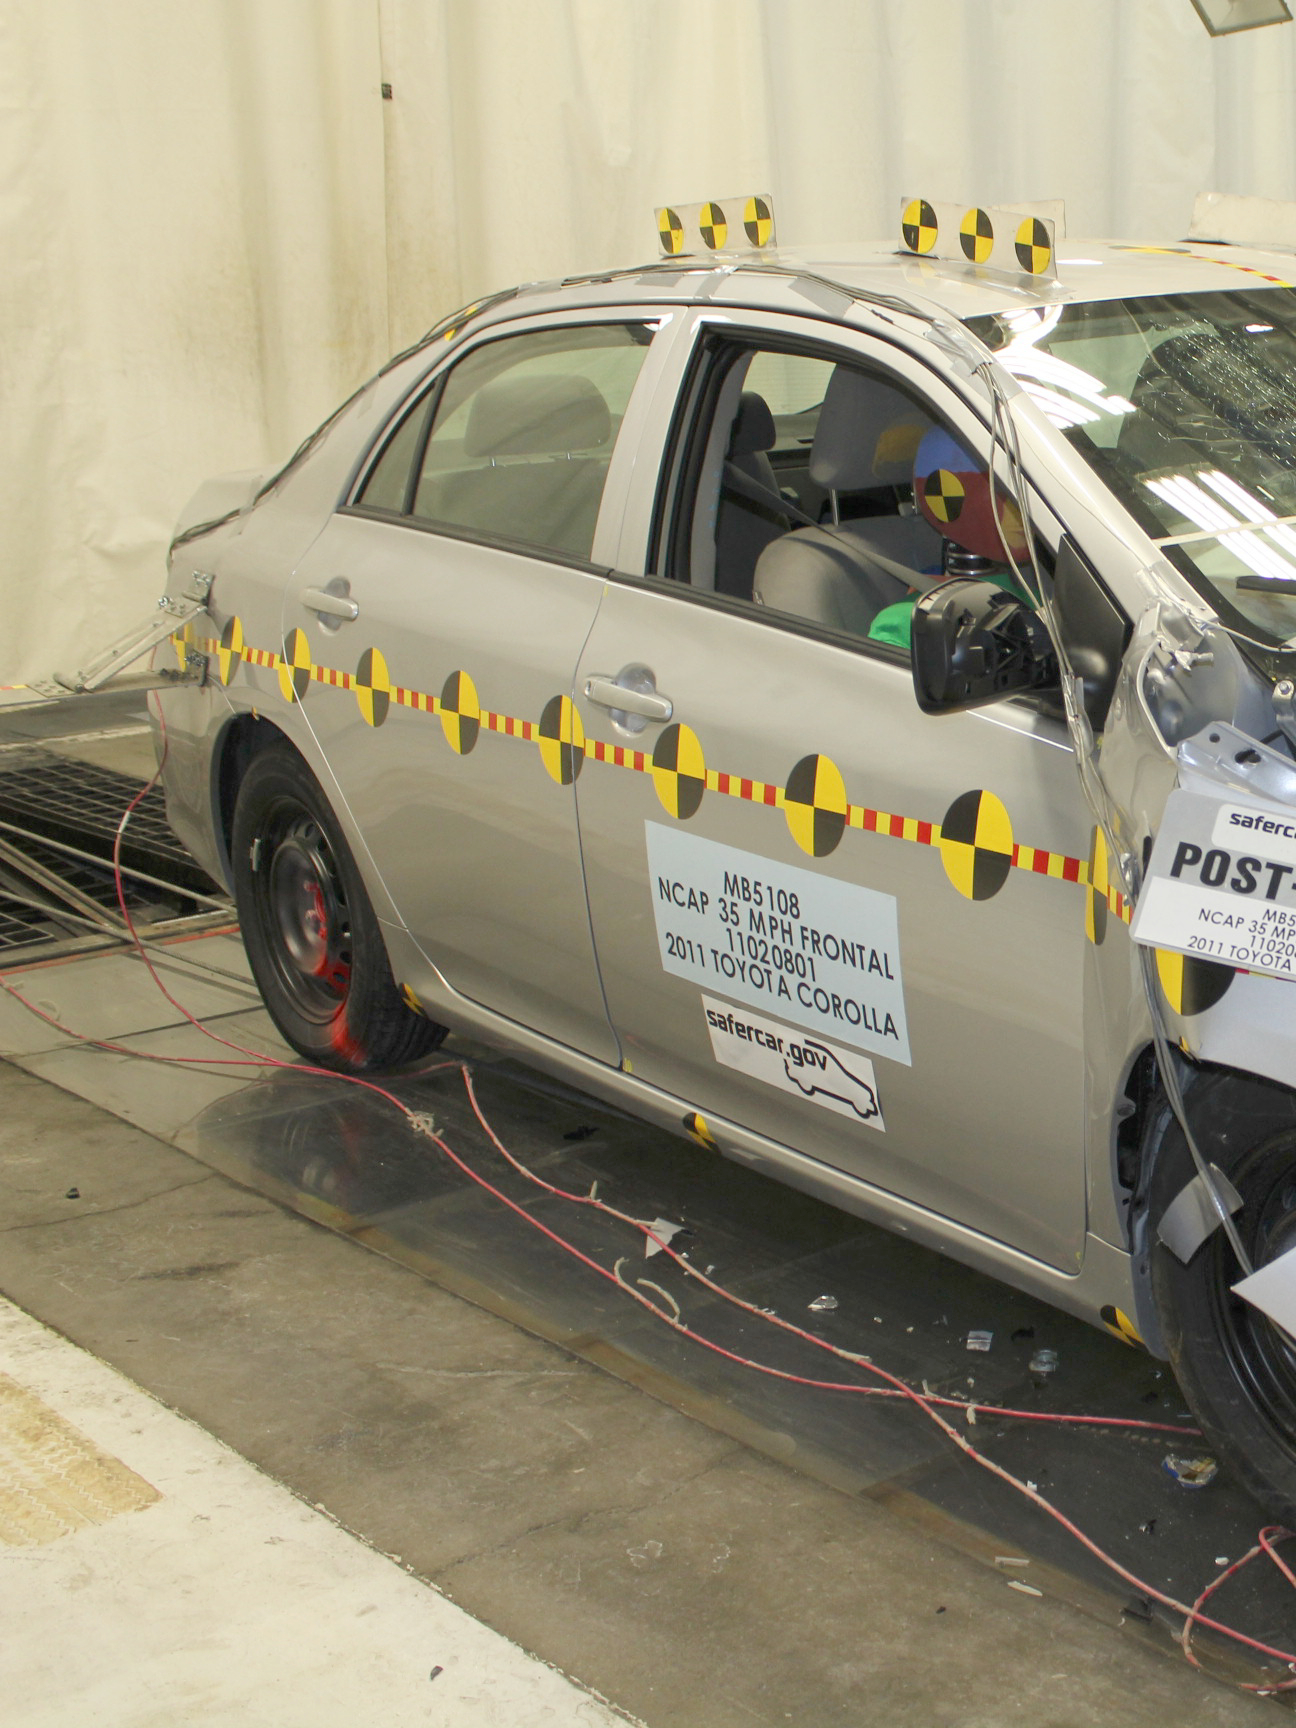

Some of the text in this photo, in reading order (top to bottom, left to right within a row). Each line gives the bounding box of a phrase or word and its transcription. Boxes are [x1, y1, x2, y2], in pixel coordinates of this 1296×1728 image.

[724, 871, 800, 919] MB5108
[1199, 908, 1245, 929] NCAP
[1248, 919, 1267, 934] 35
[658, 876, 894, 980] NCAP 35 MPH FRONTAL
[726, 928, 816, 981] 11020801
[1187, 935, 1224, 956] 2011
[1230, 946, 1291, 972] TOYOTA
[666, 932, 899, 1040] 2011 TOYOTA COROLLA
[707, 1009, 827, 1070] safercar.gov
